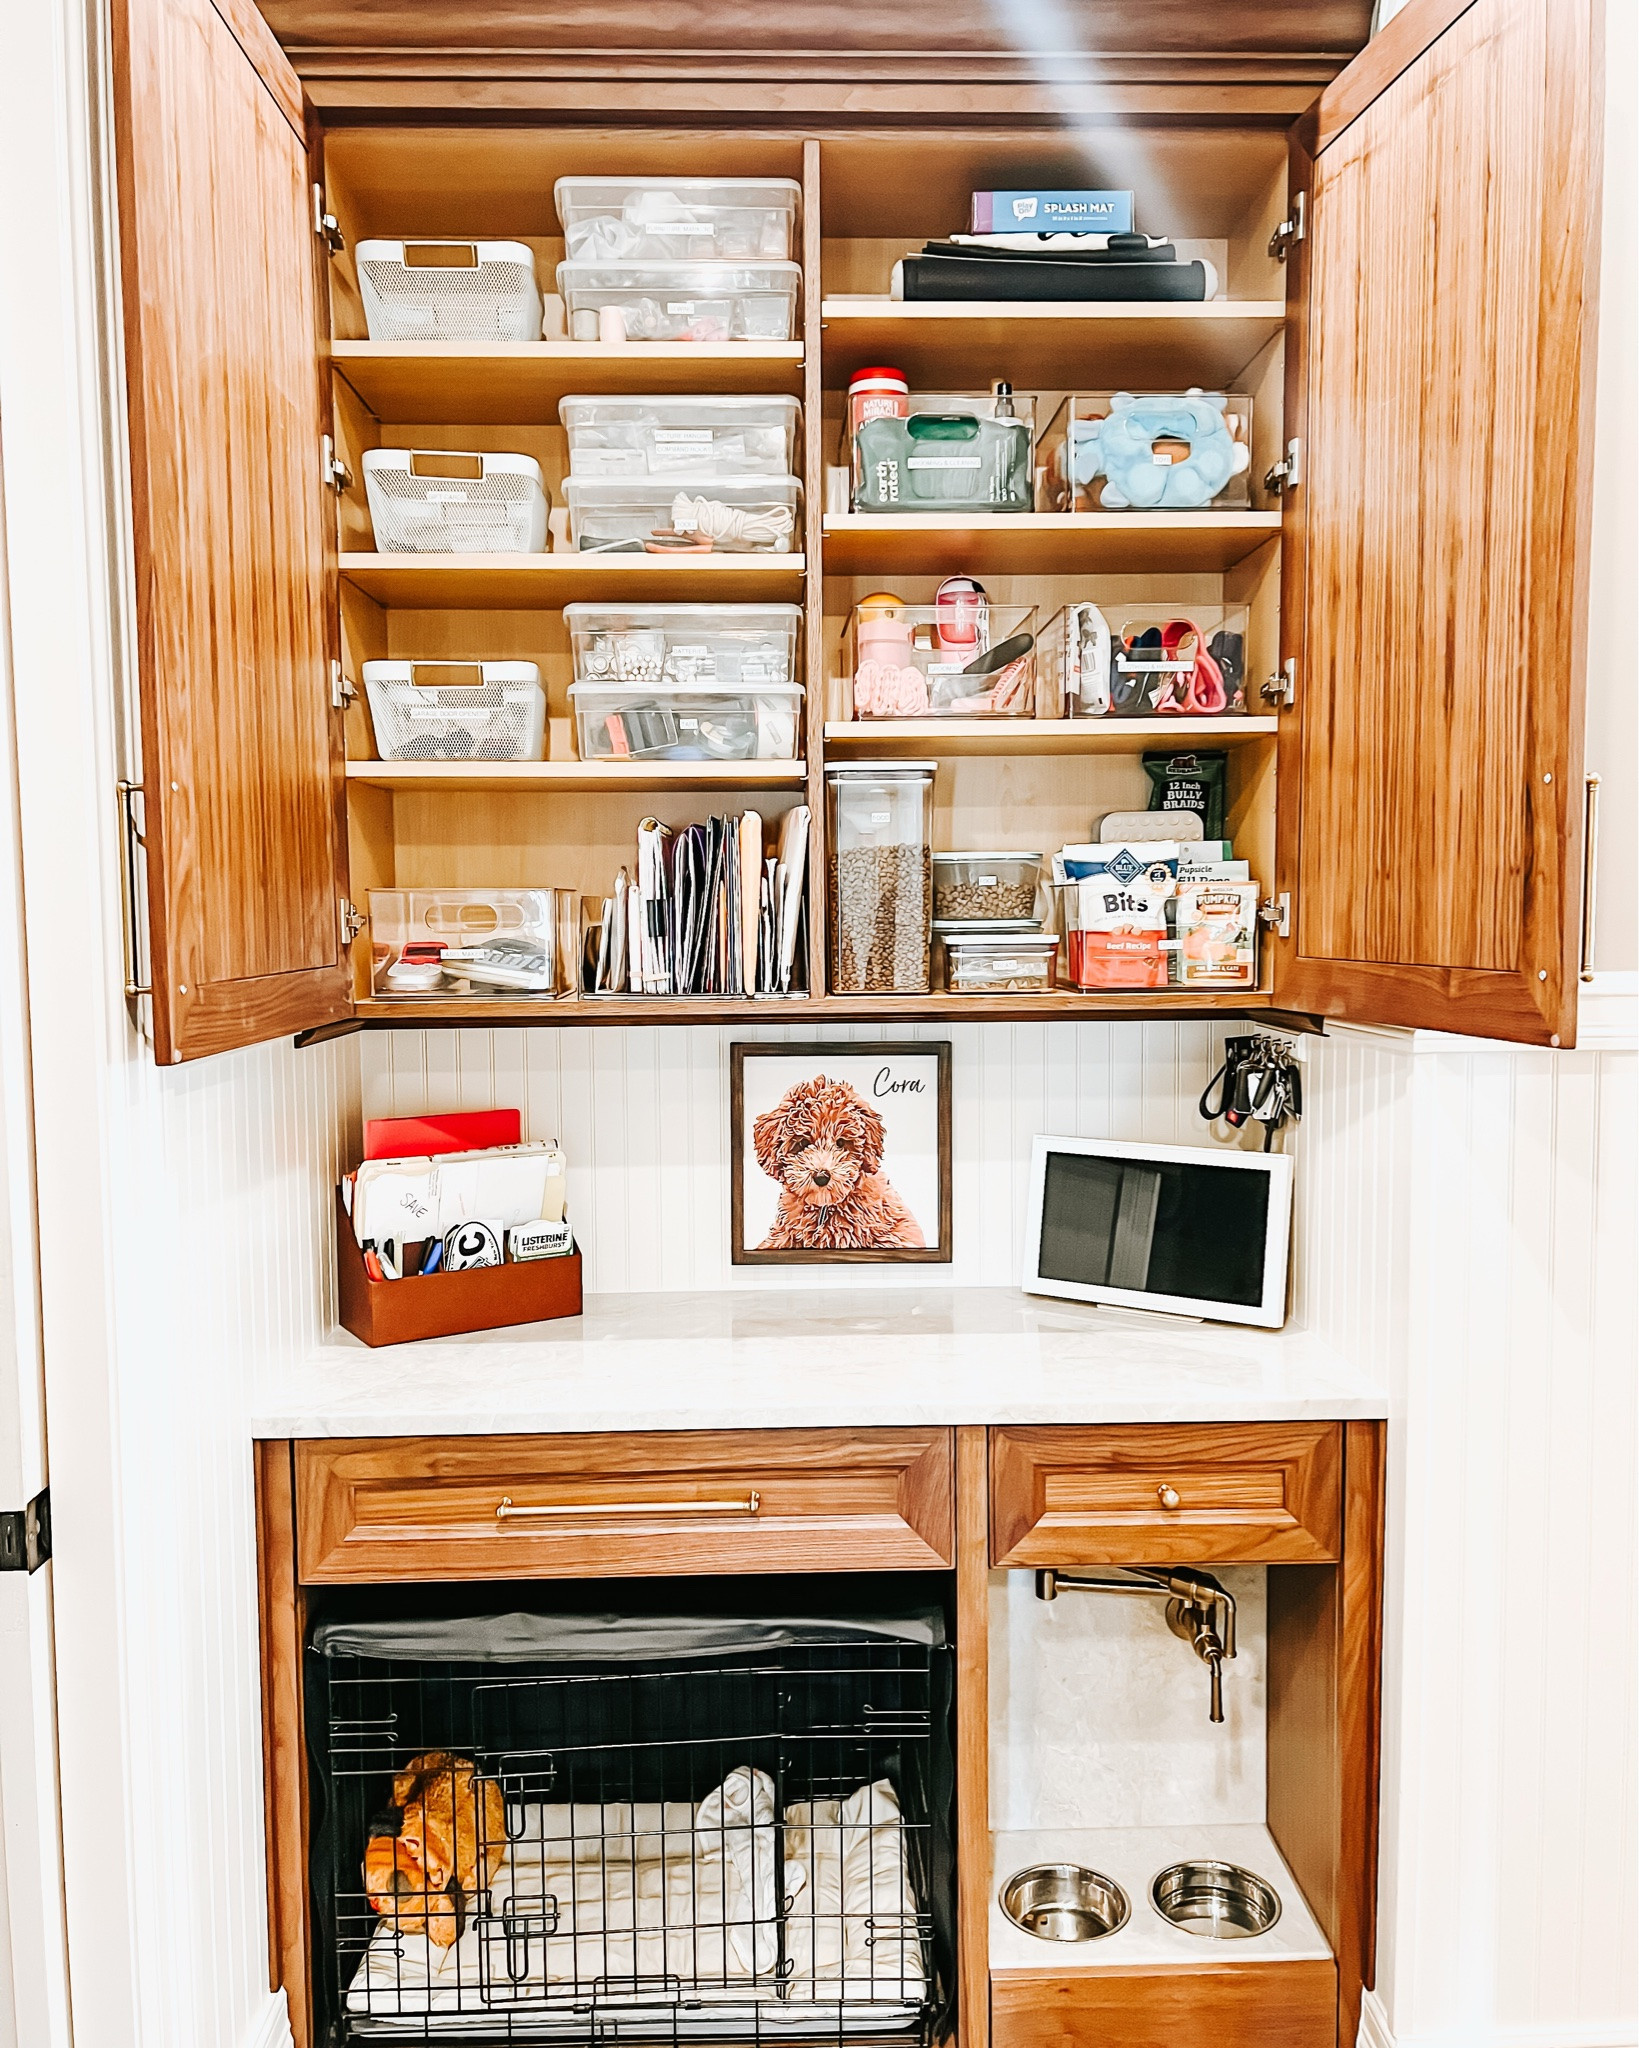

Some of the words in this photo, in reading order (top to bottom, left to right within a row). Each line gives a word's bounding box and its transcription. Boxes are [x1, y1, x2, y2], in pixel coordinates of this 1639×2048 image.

[1044, 203, 1088, 213] SPLASH
[1090, 203, 1115, 213] MAT
[876, 461, 888, 502] earth
[887, 460, 899, 502] rated
[1169, 782, 1180, 790] 12
[1182, 782, 1201, 790] Inch
[1167, 790, 1203, 800] BULLY
[1163, 800, 1205, 810] BRAIDS
[1179, 865, 1213, 874] Pupsicle
[1103, 892, 1149, 913] Bits
[1197, 895, 1239, 905] PUMPKIN
[1106, 942, 1125, 950] Beef
[1126, 942, 1151, 951] Recipe
[873, 1066, 926, 1097] Cora
[400, 1193, 428, 1218] SAVE
[521, 1232, 568, 1246] LISTERINE
[522, 1241, 566, 1252] FRESHBURST
